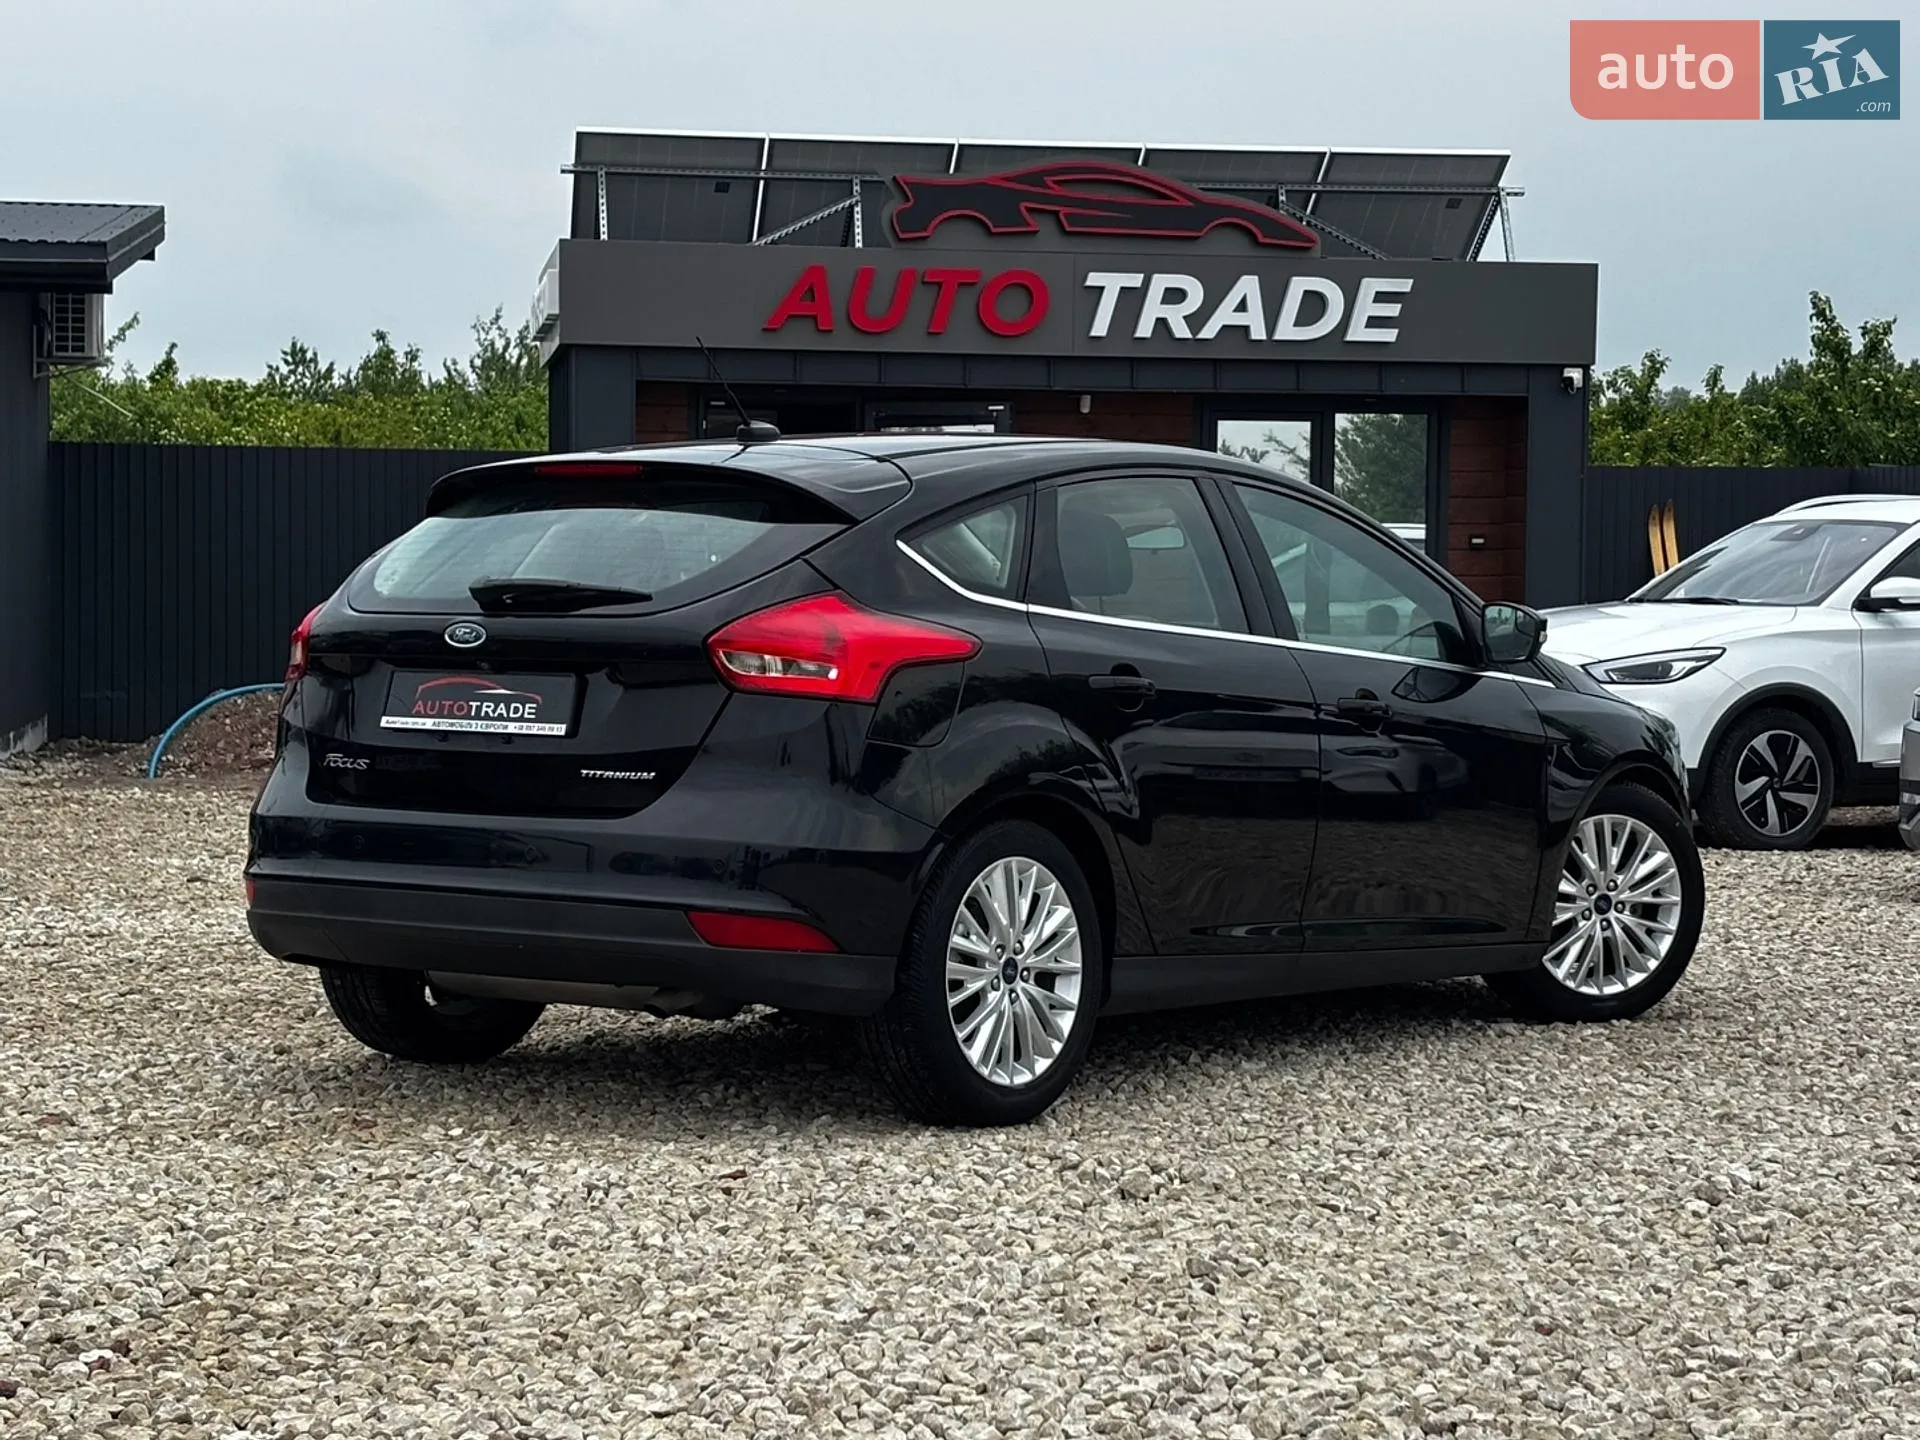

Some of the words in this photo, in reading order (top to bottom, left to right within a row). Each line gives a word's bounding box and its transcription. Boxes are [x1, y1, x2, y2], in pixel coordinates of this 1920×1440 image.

[762, 264, 1050, 336] AUTO
[1083, 271, 1415, 343] TRADE
[411, 700, 538, 719] AUTOTRADE
[580, 769, 656, 780] TITANIUM
